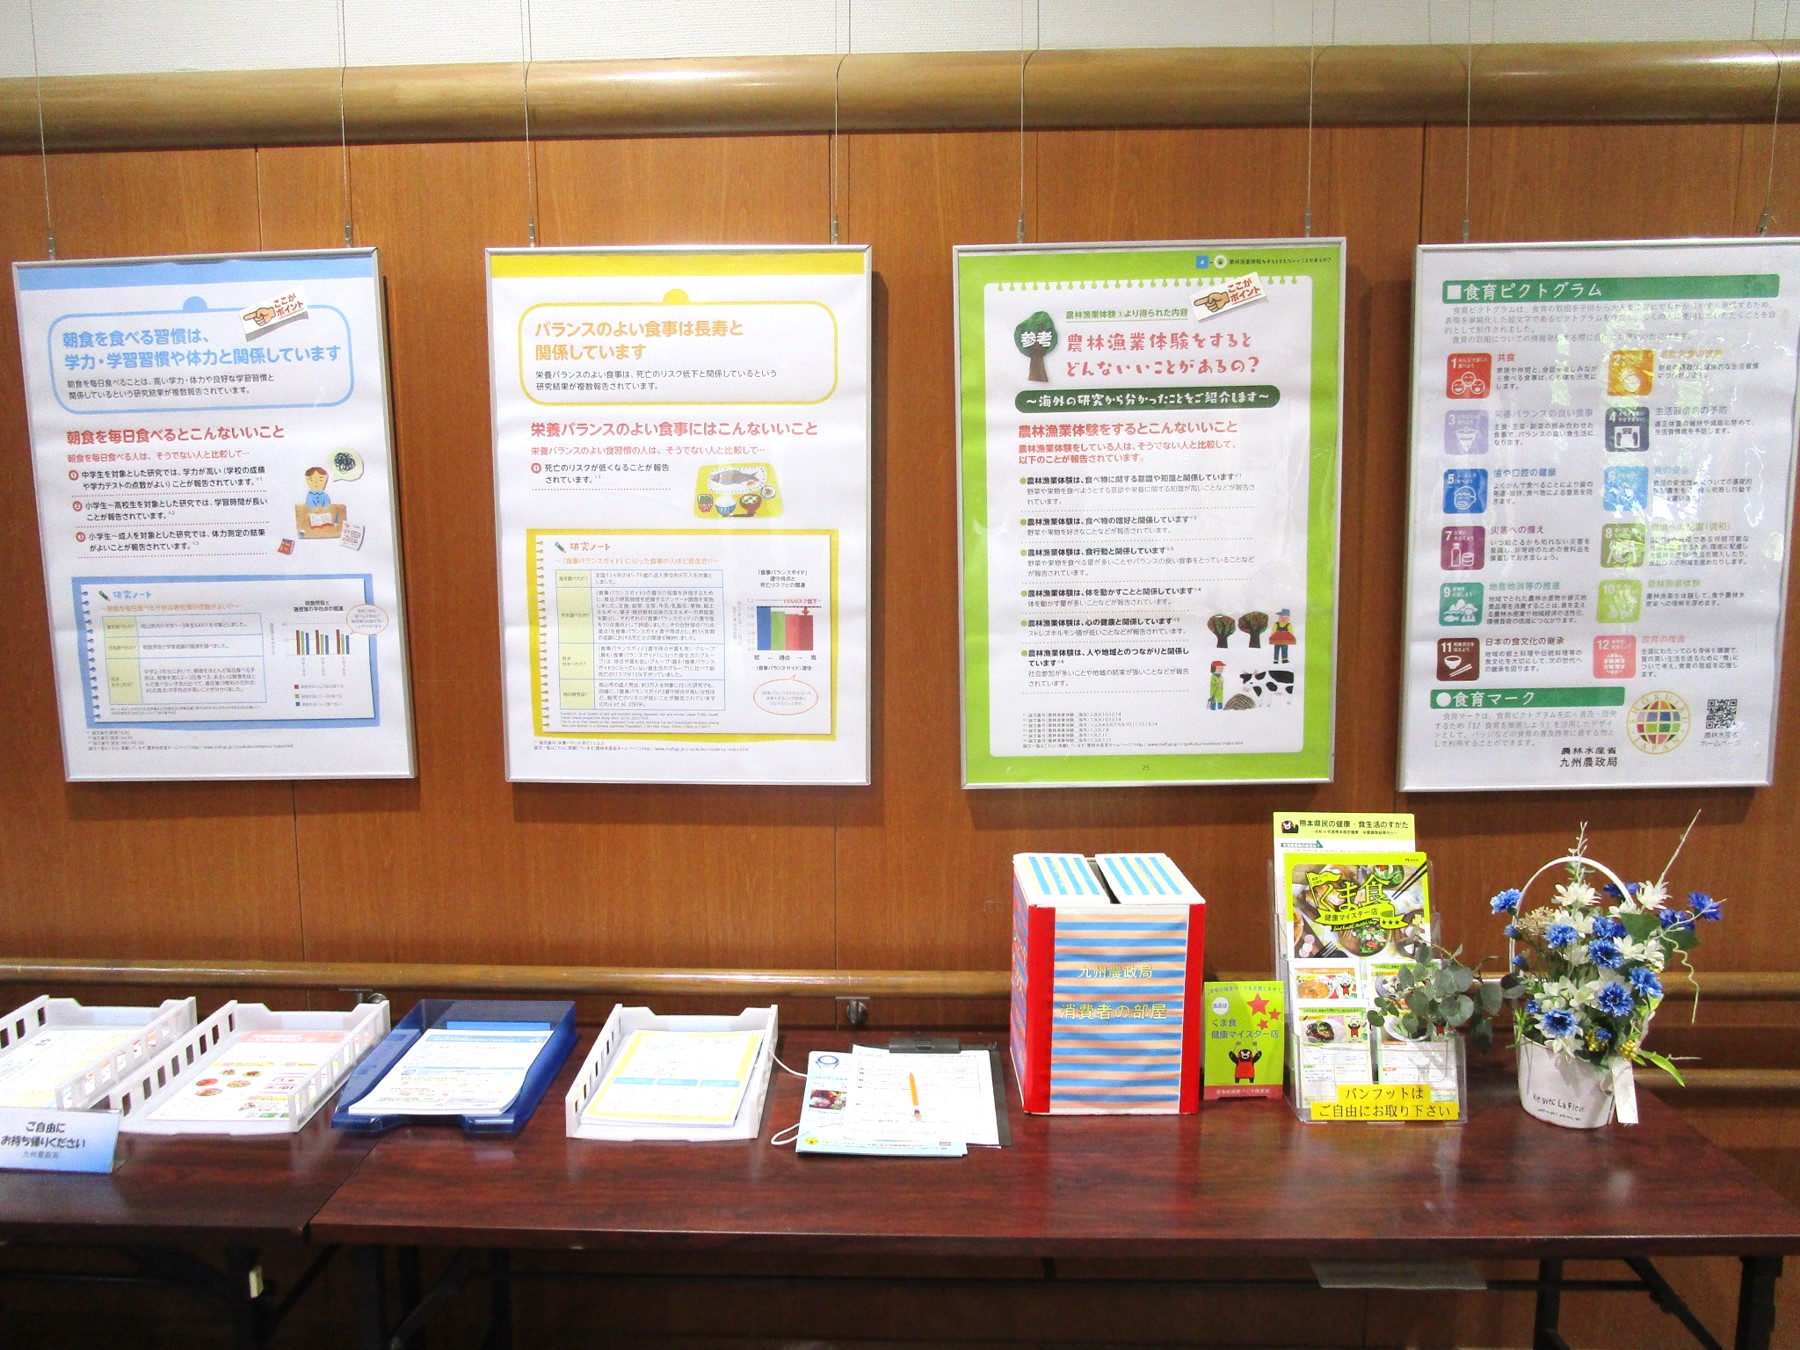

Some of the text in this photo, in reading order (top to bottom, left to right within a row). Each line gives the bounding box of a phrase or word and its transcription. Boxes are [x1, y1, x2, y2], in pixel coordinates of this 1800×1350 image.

[1227, 278, 1253, 293] ここが
[1464, 282, 1602, 301] 食育ピクトグラム
[273, 292, 297, 308] ここが
[1230, 286, 1261, 302] ポイント
[276, 300, 304, 316] ポイント
[535, 319, 744, 339] バランスのよい食事は長寿と
[62, 329, 210, 349] 朝食を食べる習慣は、
[1020, 331, 1053, 348] 参考
[1066, 331, 1252, 353] 農林漁業体験をすると
[65, 344, 341, 371] 学力・学習習慣や体力と関係しています
[535, 344, 647, 361] 関係しています
[1497, 354, 1515, 362] 共食
[535, 368, 777, 380] 栄養バランスのよい食事は、死亡のリスク低下と関係しているという
[1066, 356, 1260, 377] どんないいことがあるの？
[536, 380, 660, 391] 研究結果が複数報告されています。
[66, 425, 285, 445] 朝食を毎日食べるとこんないいこと
[531, 421, 818, 437] 栄養バランスのよい食事にはこんないいこと
[1018, 421, 1238, 439] 農林漁業体験をするとこんないいこと
[1018, 453, 1145, 465] 以下のことが報告されています。
[545, 475, 594, 485] されています。
[570, 542, 611, 551] 研究ノート
[1441, 642, 1451, 653] 11
[1598, 640, 1609, 650] 12
[1453, 691, 1535, 707] 食育マーク
[1561, 747, 1616, 755] 農林水産省
[1559, 757, 1618, 768] 九州農政局
[1320, 874, 1392, 912] くま食
[1077, 965, 1153, 979] 九州農政局
[1060, 1003, 1167, 1020] 消費者の部屋
[1212, 1019, 1237, 1027] くま食
[1211, 1030, 1279, 1039] 健康マイスター店
[1319, 1104, 1451, 1118] ご自由にお取り下さい
[25, 1121, 66, 1133] ご自由に
[0, 1135, 86, 1149] お持ち帰りください
